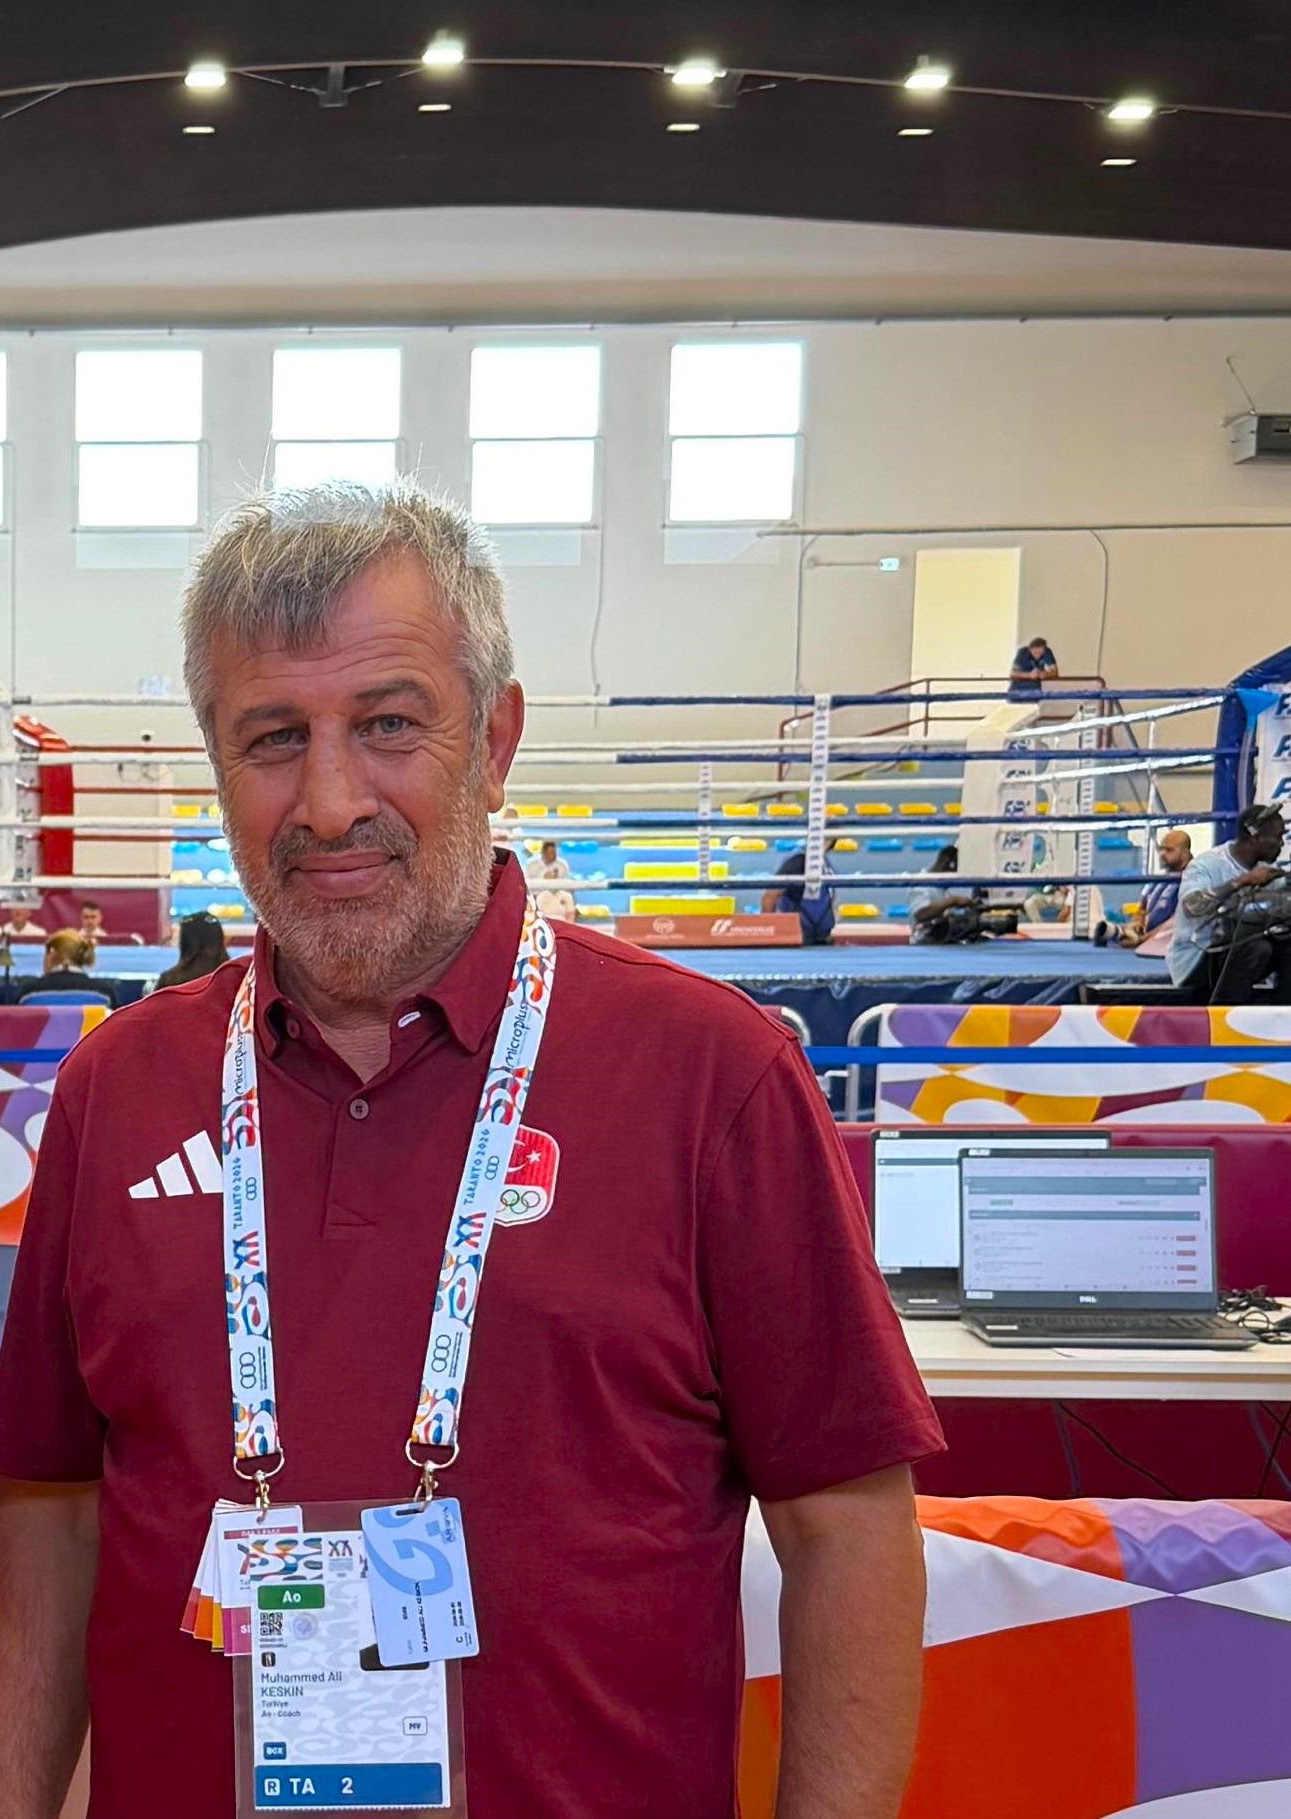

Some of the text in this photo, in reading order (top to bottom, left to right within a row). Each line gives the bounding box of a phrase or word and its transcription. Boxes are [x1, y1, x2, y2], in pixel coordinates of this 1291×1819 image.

[505, 1003, 530, 1068] microplus
[463, 1158, 484, 1206] TARANTO
[261, 1671, 342, 1683] Muhammed Ali
[261, 1686, 304, 1698] KESKIN
[289, 1777, 315, 1795] TA
[341, 1777, 354, 1794] 2
